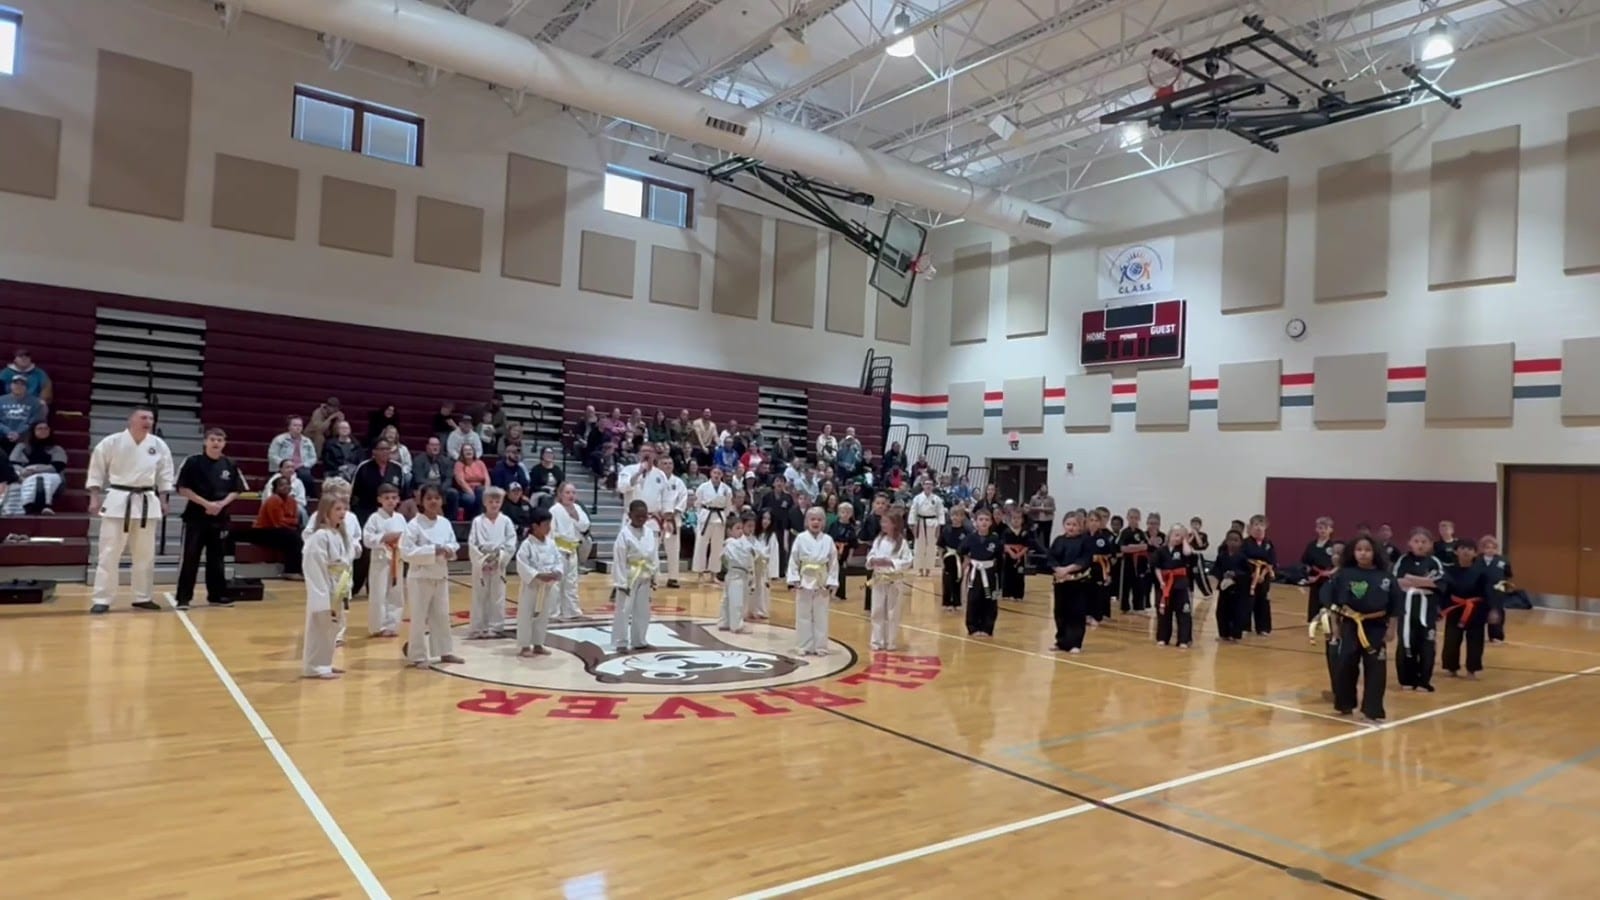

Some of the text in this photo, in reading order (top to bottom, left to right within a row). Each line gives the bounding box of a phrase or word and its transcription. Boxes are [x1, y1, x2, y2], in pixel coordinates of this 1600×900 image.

[1151, 324, 1175, 335] GUEST
[1086, 332, 1106, 341] HOME
[456, 685, 867, 721] RIVER
